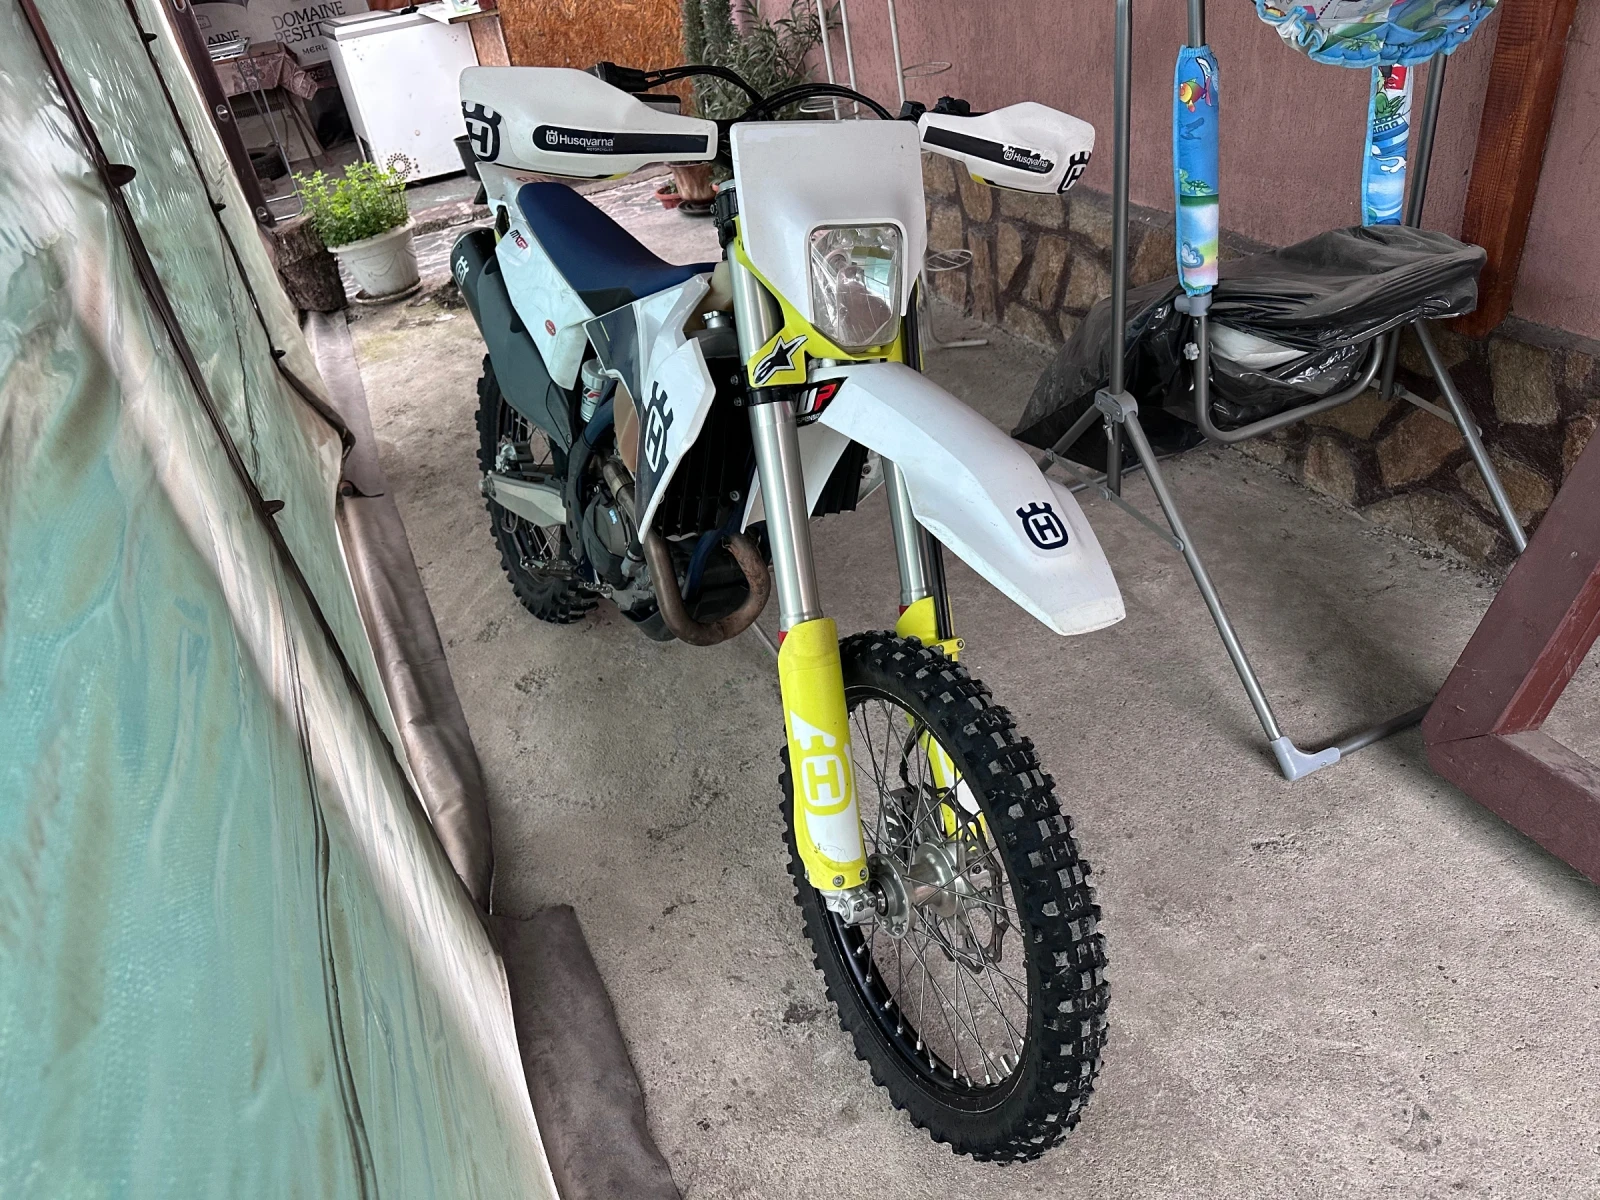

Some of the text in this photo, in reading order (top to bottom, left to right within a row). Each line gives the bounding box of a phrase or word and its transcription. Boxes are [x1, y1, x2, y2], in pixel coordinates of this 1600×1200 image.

[271, 1, 346, 31] DOMAINE
[559, 134, 614, 148] Husqvarna
[1012, 152, 1049, 168] Husqvarna
